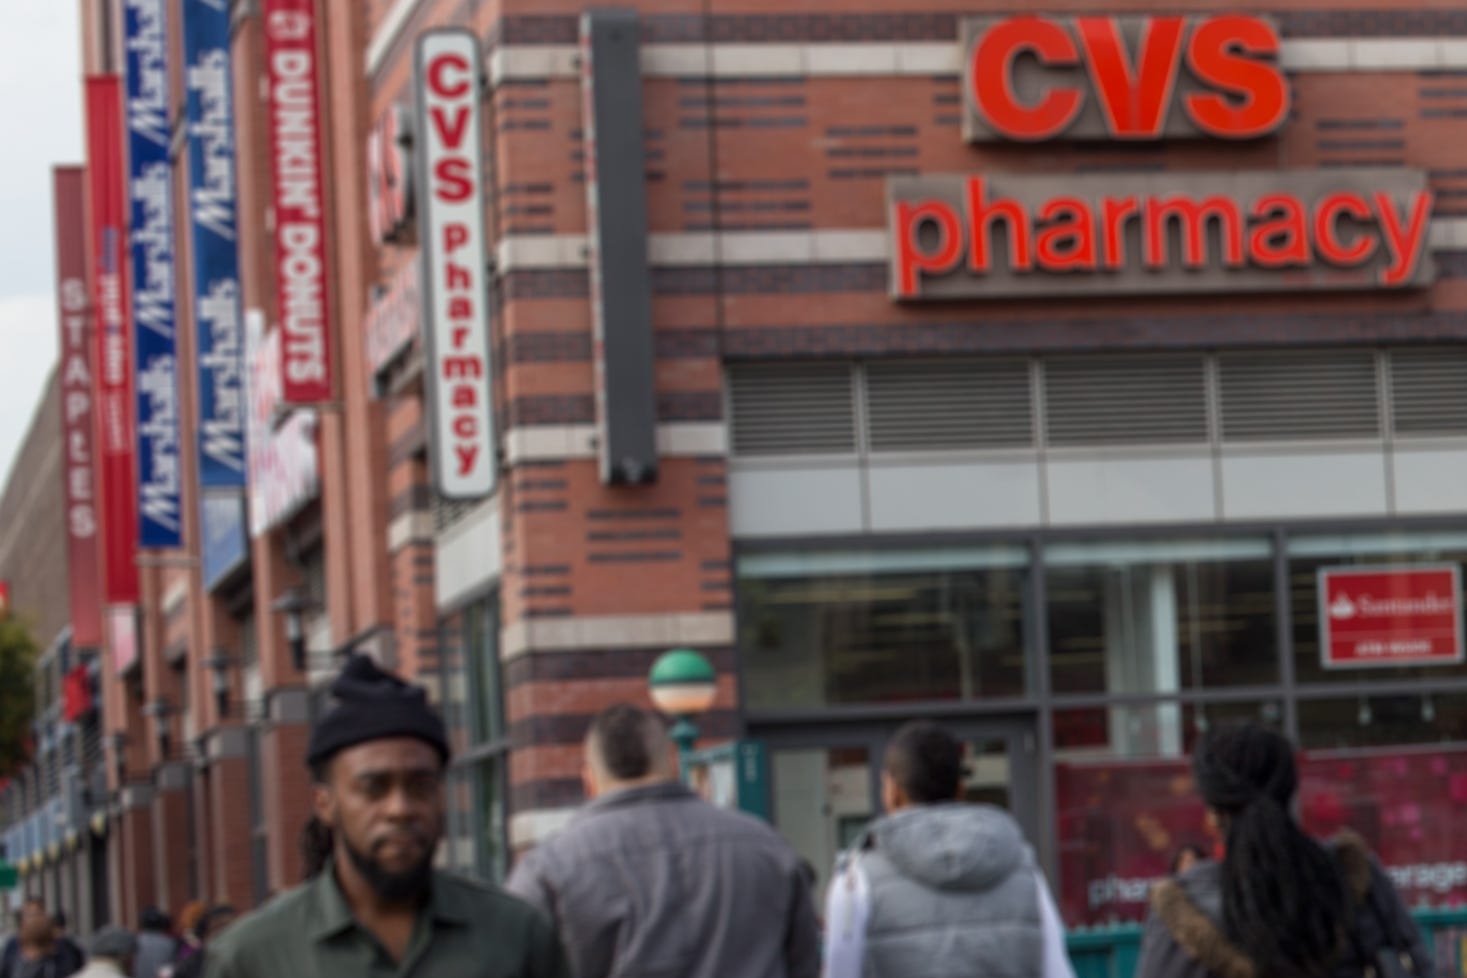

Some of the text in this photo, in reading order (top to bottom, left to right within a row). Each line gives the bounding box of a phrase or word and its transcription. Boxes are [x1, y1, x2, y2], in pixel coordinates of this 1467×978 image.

[187, 47, 235, 241] Marshalls
[272, 50, 317, 219] DUNKIN'
[972, 13, 1289, 139] CVS
[132, 161, 176, 339] Marshalls
[280, 222, 327, 384] DONUTS
[426, 52, 484, 479] CVS pharmacy
[895, 176, 1434, 296] pharmacy
[61, 278, 96, 539] STAPLES
[138, 354, 181, 533] Marshalls
[200, 277, 245, 473] Marshalls
